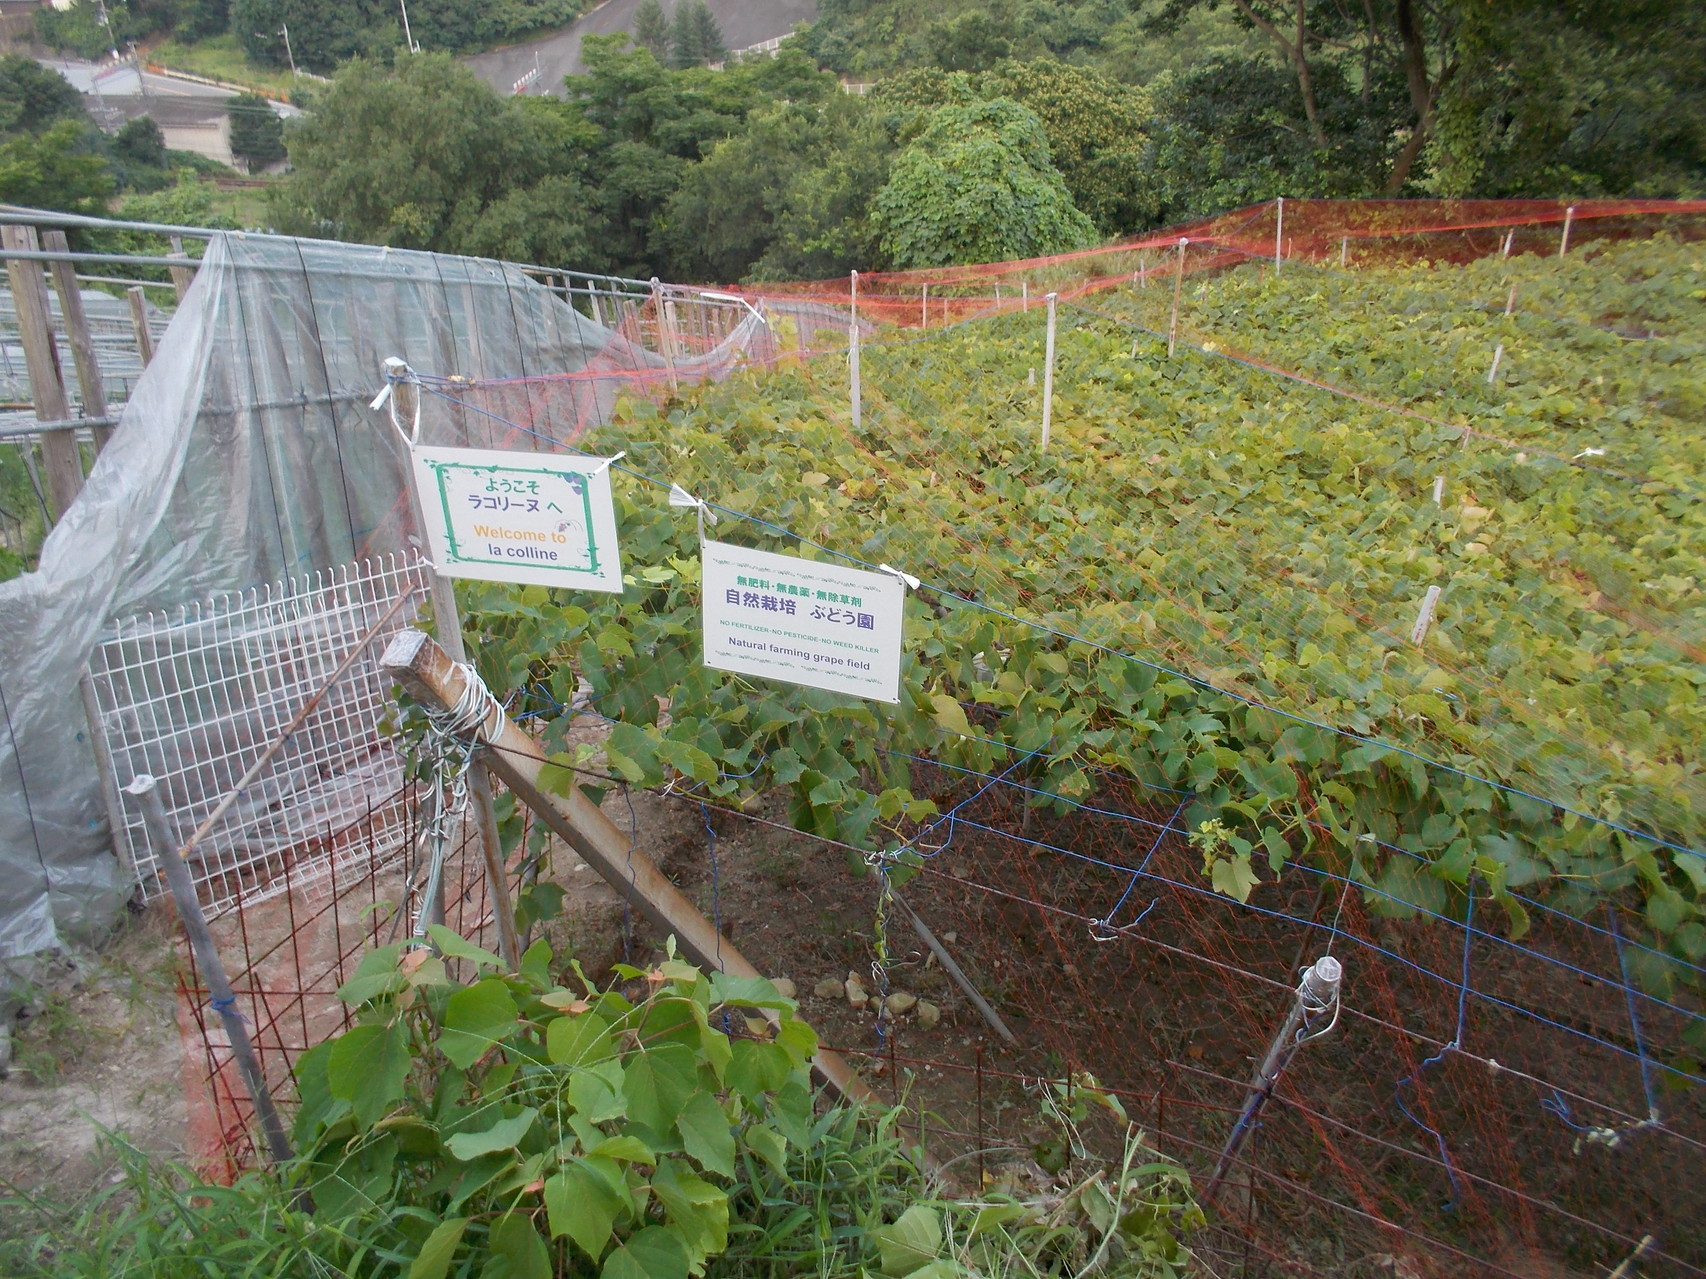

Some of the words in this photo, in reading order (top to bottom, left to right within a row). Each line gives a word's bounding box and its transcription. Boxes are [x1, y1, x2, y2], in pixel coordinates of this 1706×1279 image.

[485, 478, 540, 495] ようこそ
[468, 494, 540, 512] ラコリーヌ
[547, 502, 563, 514] へ
[473, 524, 546, 542] Welcome
[551, 532, 567, 544] to
[488, 543, 502, 556] la
[507, 546, 558, 561] colline
[726, 588, 797, 616] 自然栽培
[810, 604, 874, 630] ぶどう園
[728, 636, 767, 651] Natural
[769, 643, 811, 661] farming
[813, 653, 844, 666] grape
[847, 658, 871, 671] field
[833, 640, 854, 649] WEED
[854, 644, 879, 654] KILLER
